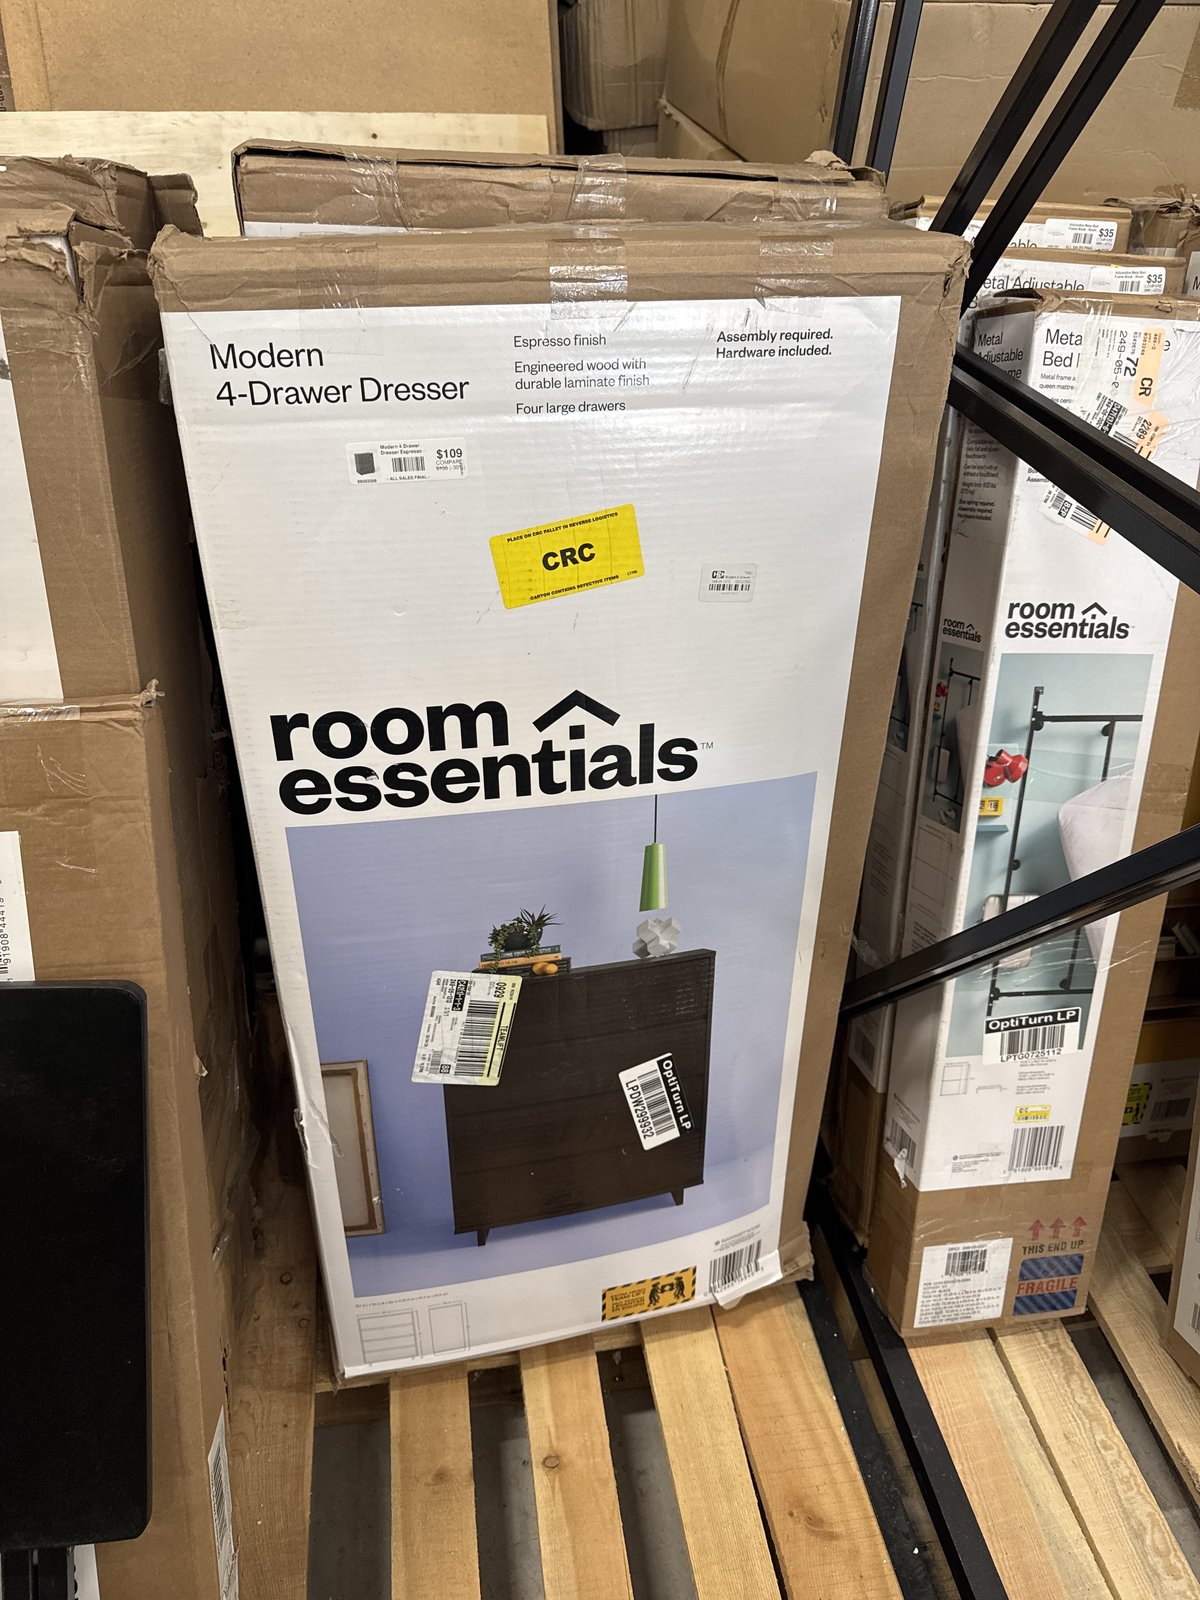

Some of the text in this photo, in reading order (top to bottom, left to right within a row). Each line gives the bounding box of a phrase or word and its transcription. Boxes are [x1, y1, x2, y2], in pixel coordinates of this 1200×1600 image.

[1098, 228, 1115, 238] $35
[982, 275, 1009, 290] etal
[1146, 274, 1163, 284] $35
[513, 334, 607, 350] Espresso finish
[716, 328, 833, 343] Assembly required.
[977, 331, 1004, 347] Metal
[1045, 328, 1083, 346] Meta
[210, 342, 324, 370] Modern
[716, 344, 832, 359] Hardware included.
[1042, 350, 1073, 368] Bed
[514, 358, 647, 376] Engineered wood with
[1123, 357, 1140, 377] 72
[515, 374, 650, 390] durable laminate finish
[1040, 373, 1072, 382] Metal frame
[216, 377, 470, 406] 4-Drawer Dresser
[1039, 383, 1056, 391] queen
[1138, 377, 1154, 397] CR
[516, 401, 627, 416] Four large drawers
[1136, 419, 1153, 440] 2289
[436, 448, 463, 460] $109
[1060, 500, 1072, 518] 82P
[506, 535, 524, 543] PLACE
[543, 525, 562, 534] PALLET
[569, 518, 592, 528] REVERSE
[592, 512, 619, 523] LOGISTICS
[542, 542, 596, 571] CRC
[530, 574, 620, 601] CARTON CONTAINS DEFECTIVE ITEMS
[1007, 602, 1075, 620] room
[943, 617, 965, 630] room
[1004, 613, 1130, 640] essentials
[942, 627, 982, 643] essentials
[270, 700, 509, 761] room
[279, 722, 715, 815] essentials TM
[0, 933, 12, 964] 91908
[493, 981, 507, 999] 0929
[988, 1010, 1077, 1031] OptiTurn LP
[496, 1025, 509, 1051] TEAMLIFT
[999, 1048, 1063, 1063] LPTG0725112
[662, 1060, 692, 1129] OptiTurn LP
[625, 1078, 655, 1140] LPDW299932
[1022, 1239, 1085, 1256] THIS END UP
[1016, 1276, 1078, 1296] FRAGILE
